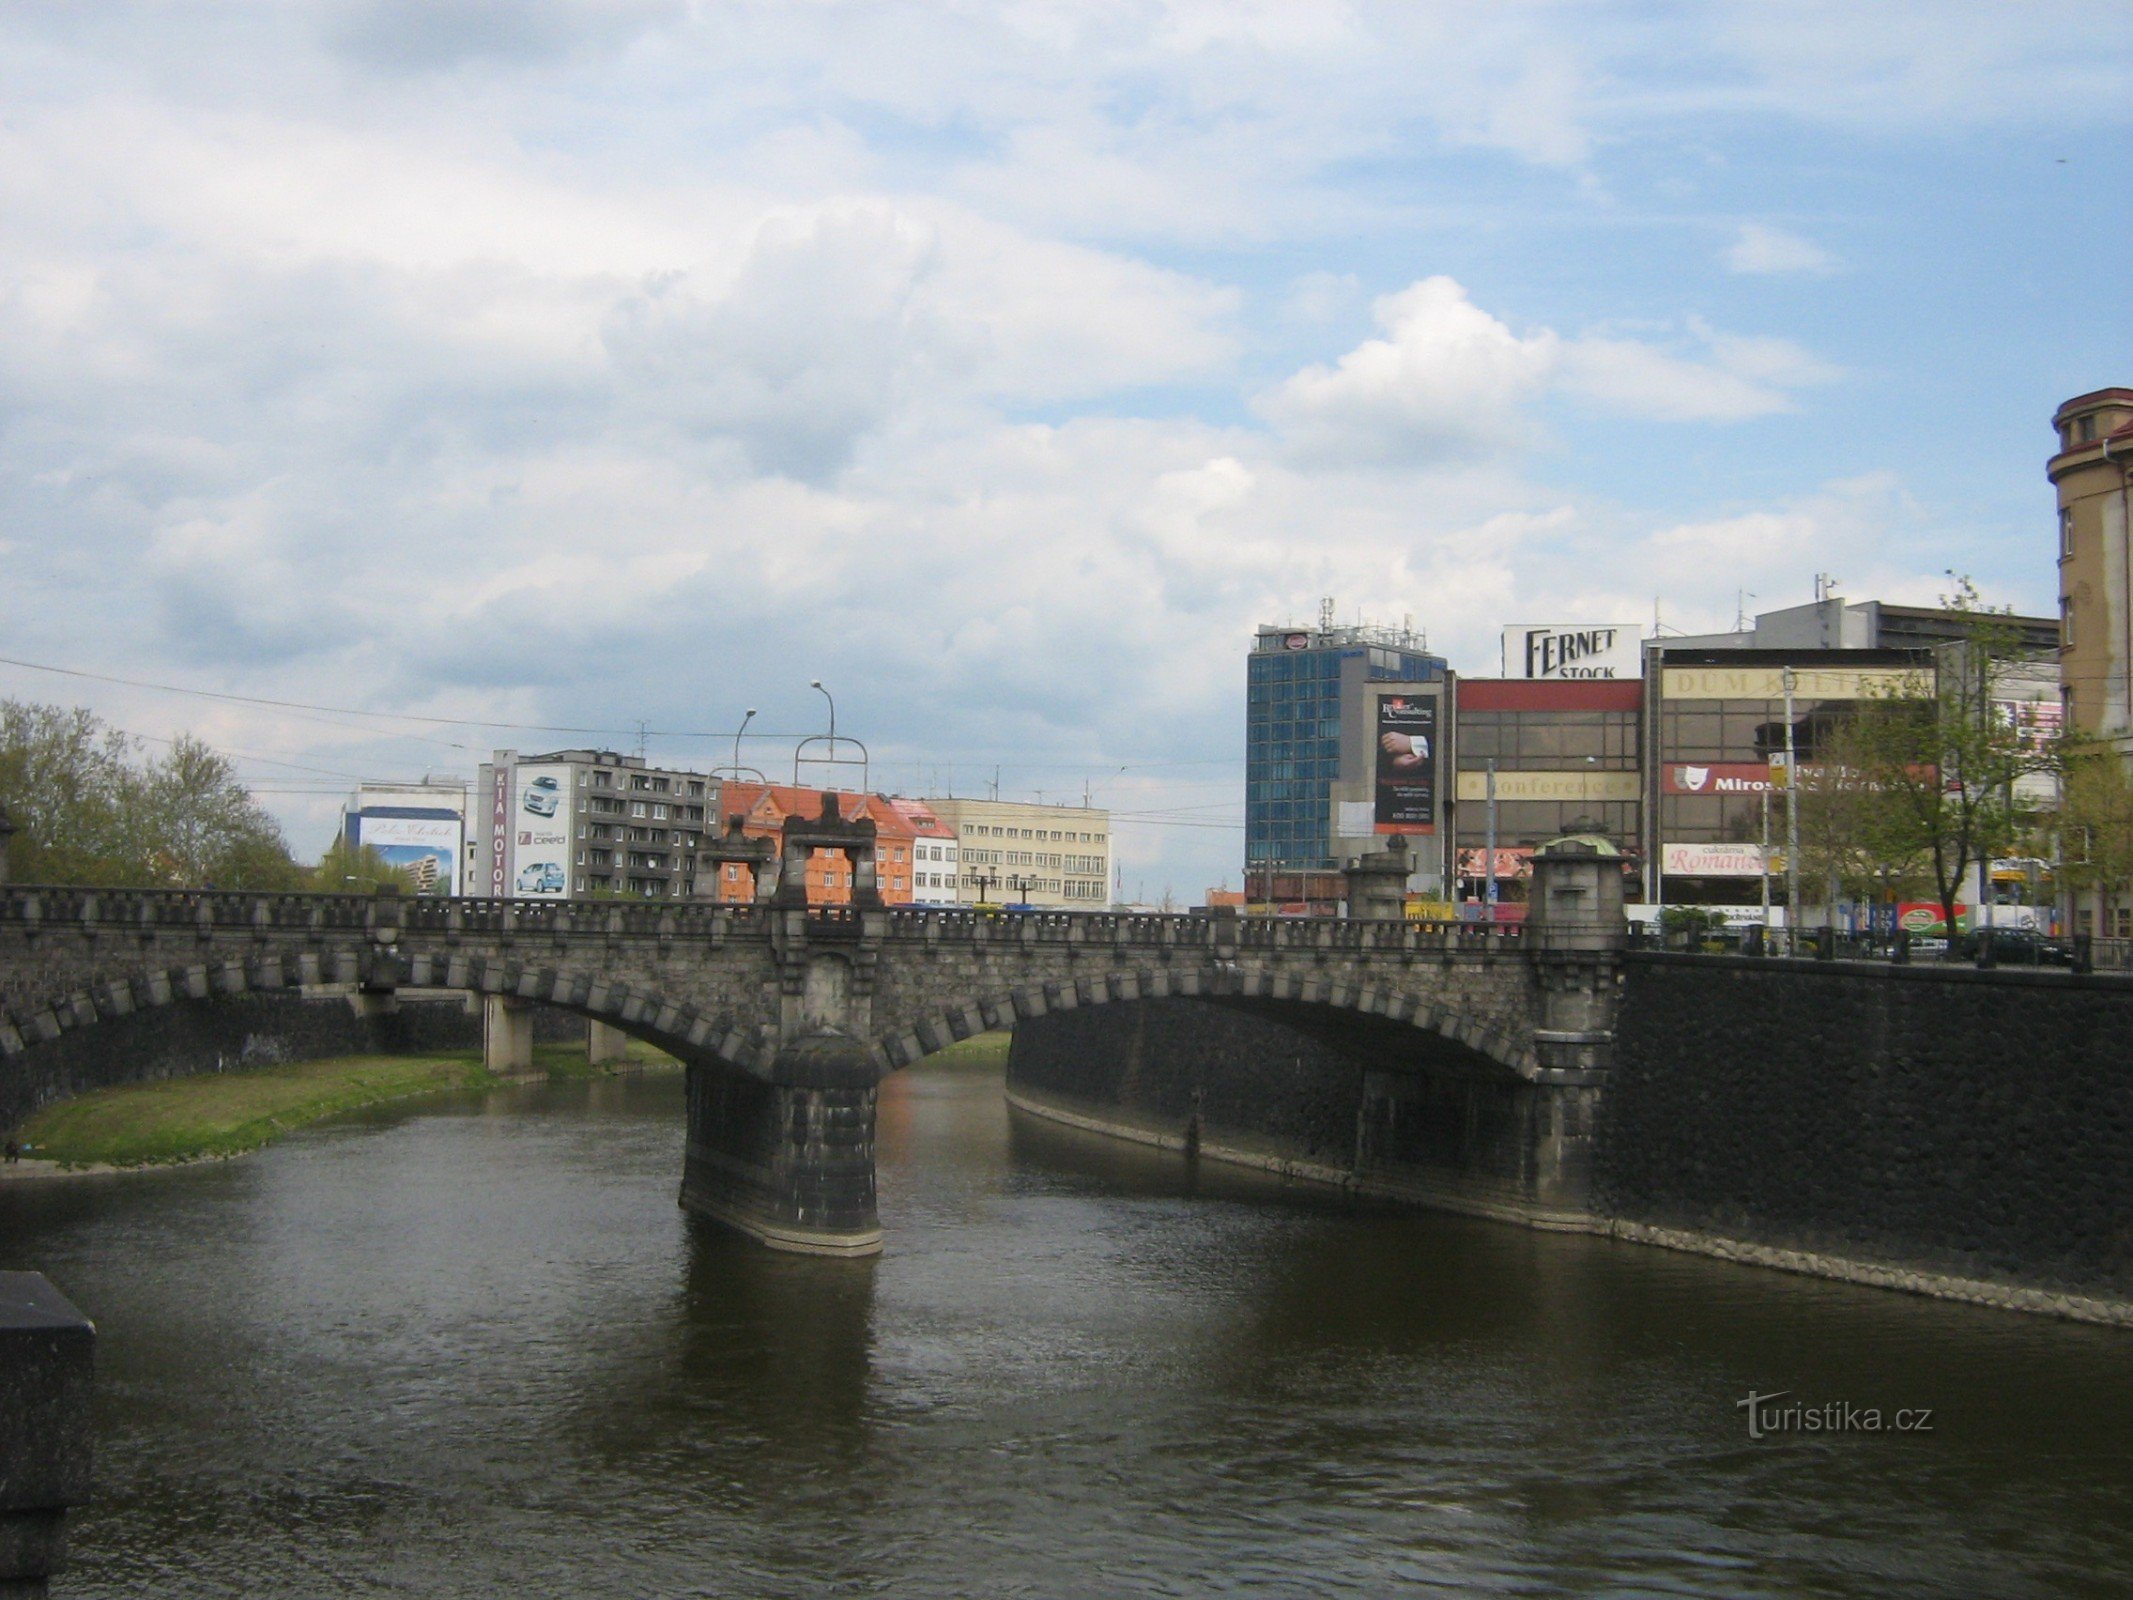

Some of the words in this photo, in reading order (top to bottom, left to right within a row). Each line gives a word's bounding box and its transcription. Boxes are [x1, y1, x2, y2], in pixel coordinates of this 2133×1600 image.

[1526, 629, 1618, 678] FERNET
[1560, 667, 1616, 678] STOCK
[495, 774, 505, 814] KIA
[1488, 777, 1615, 794] onference
